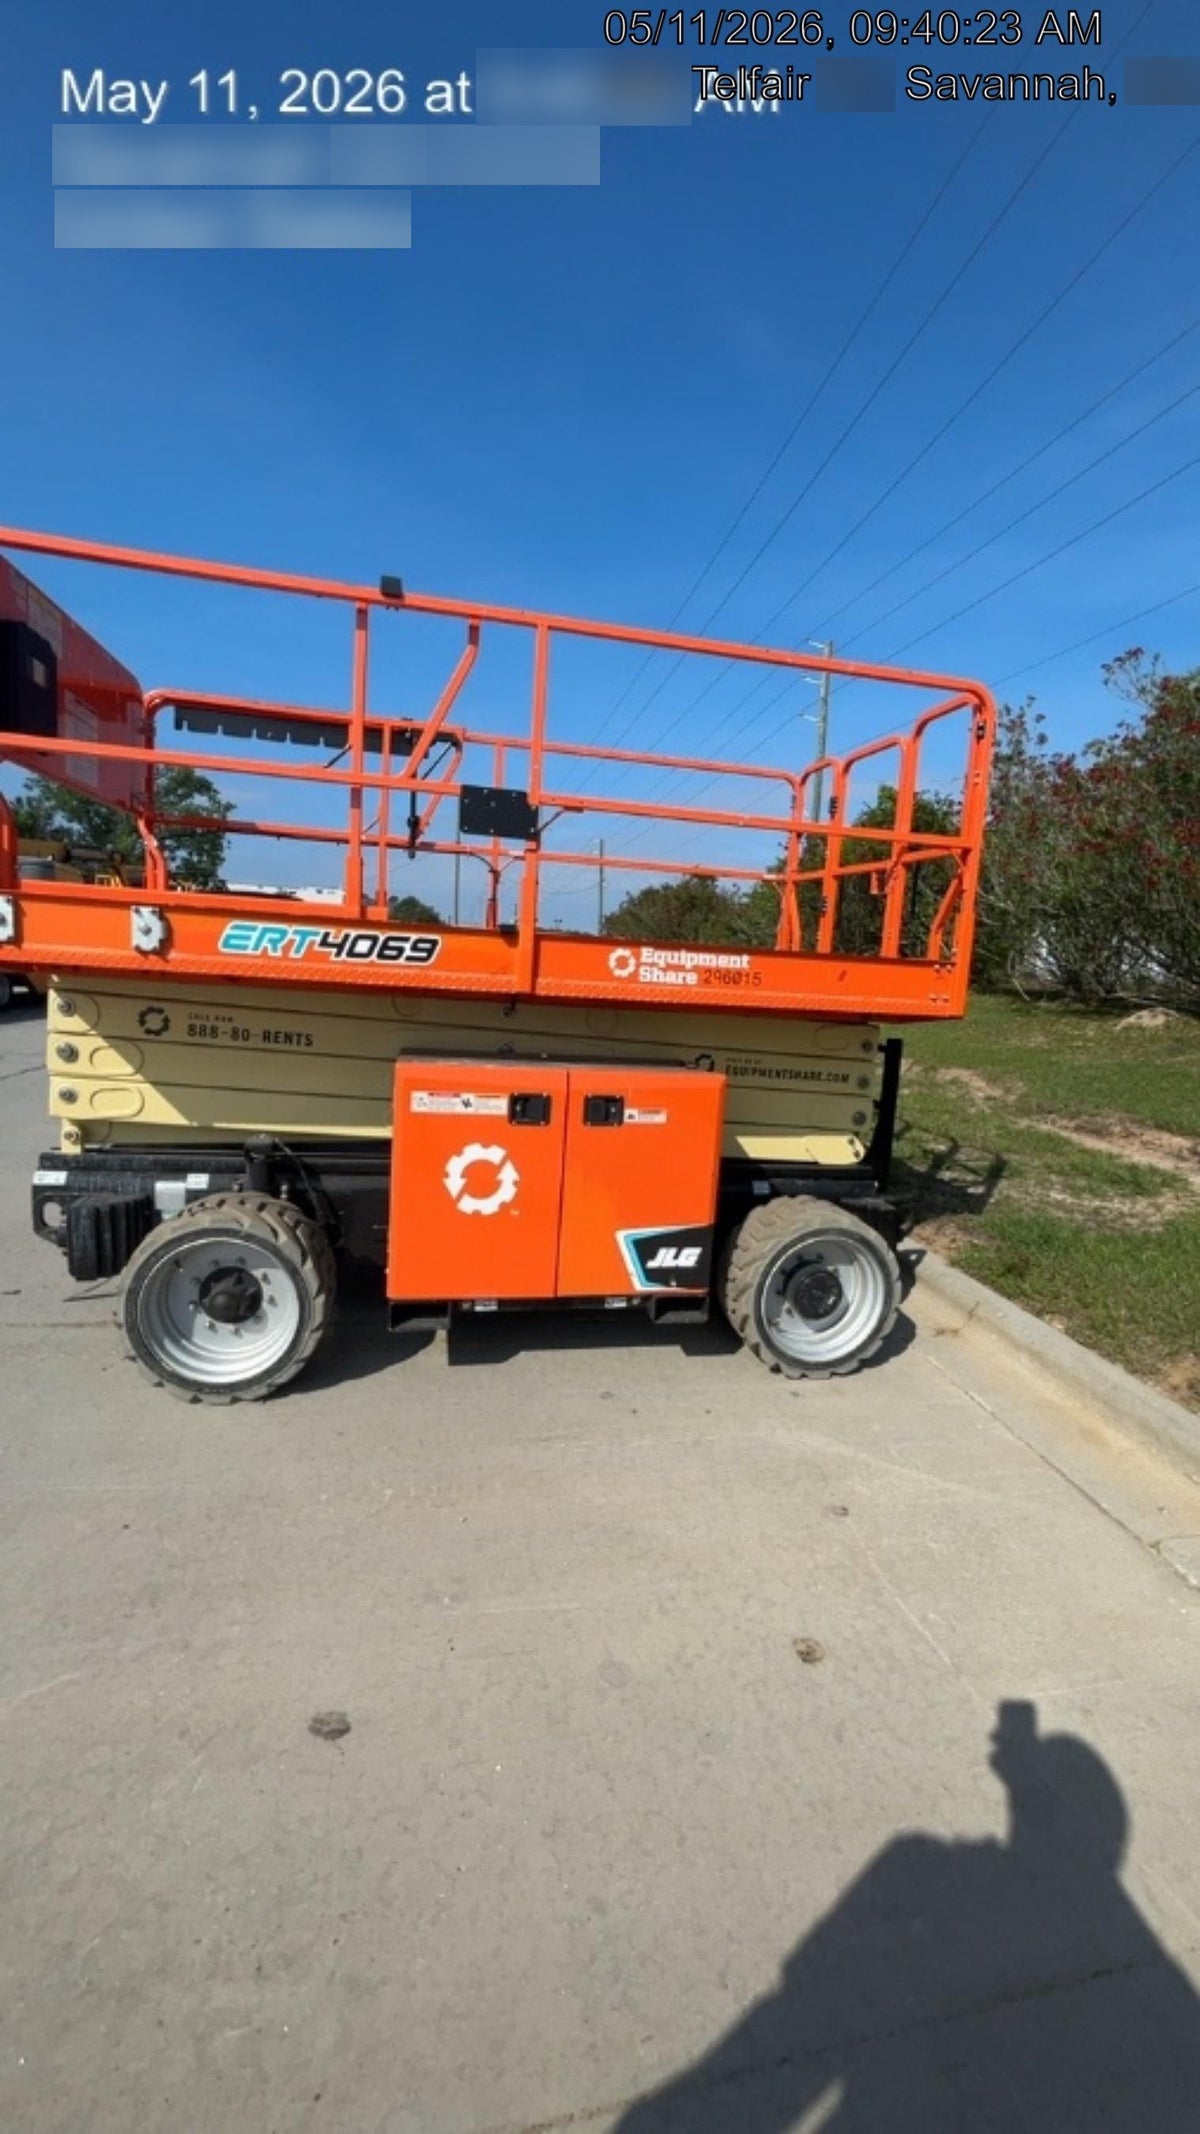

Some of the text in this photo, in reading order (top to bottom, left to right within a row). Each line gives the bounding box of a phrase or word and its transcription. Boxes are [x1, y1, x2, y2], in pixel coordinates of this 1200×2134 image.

[219, 922, 441, 965] ERT4069
[639, 947, 750, 969] Equipment
[639, 966, 699, 985] Share
[645, 1247, 702, 1269] JLG
